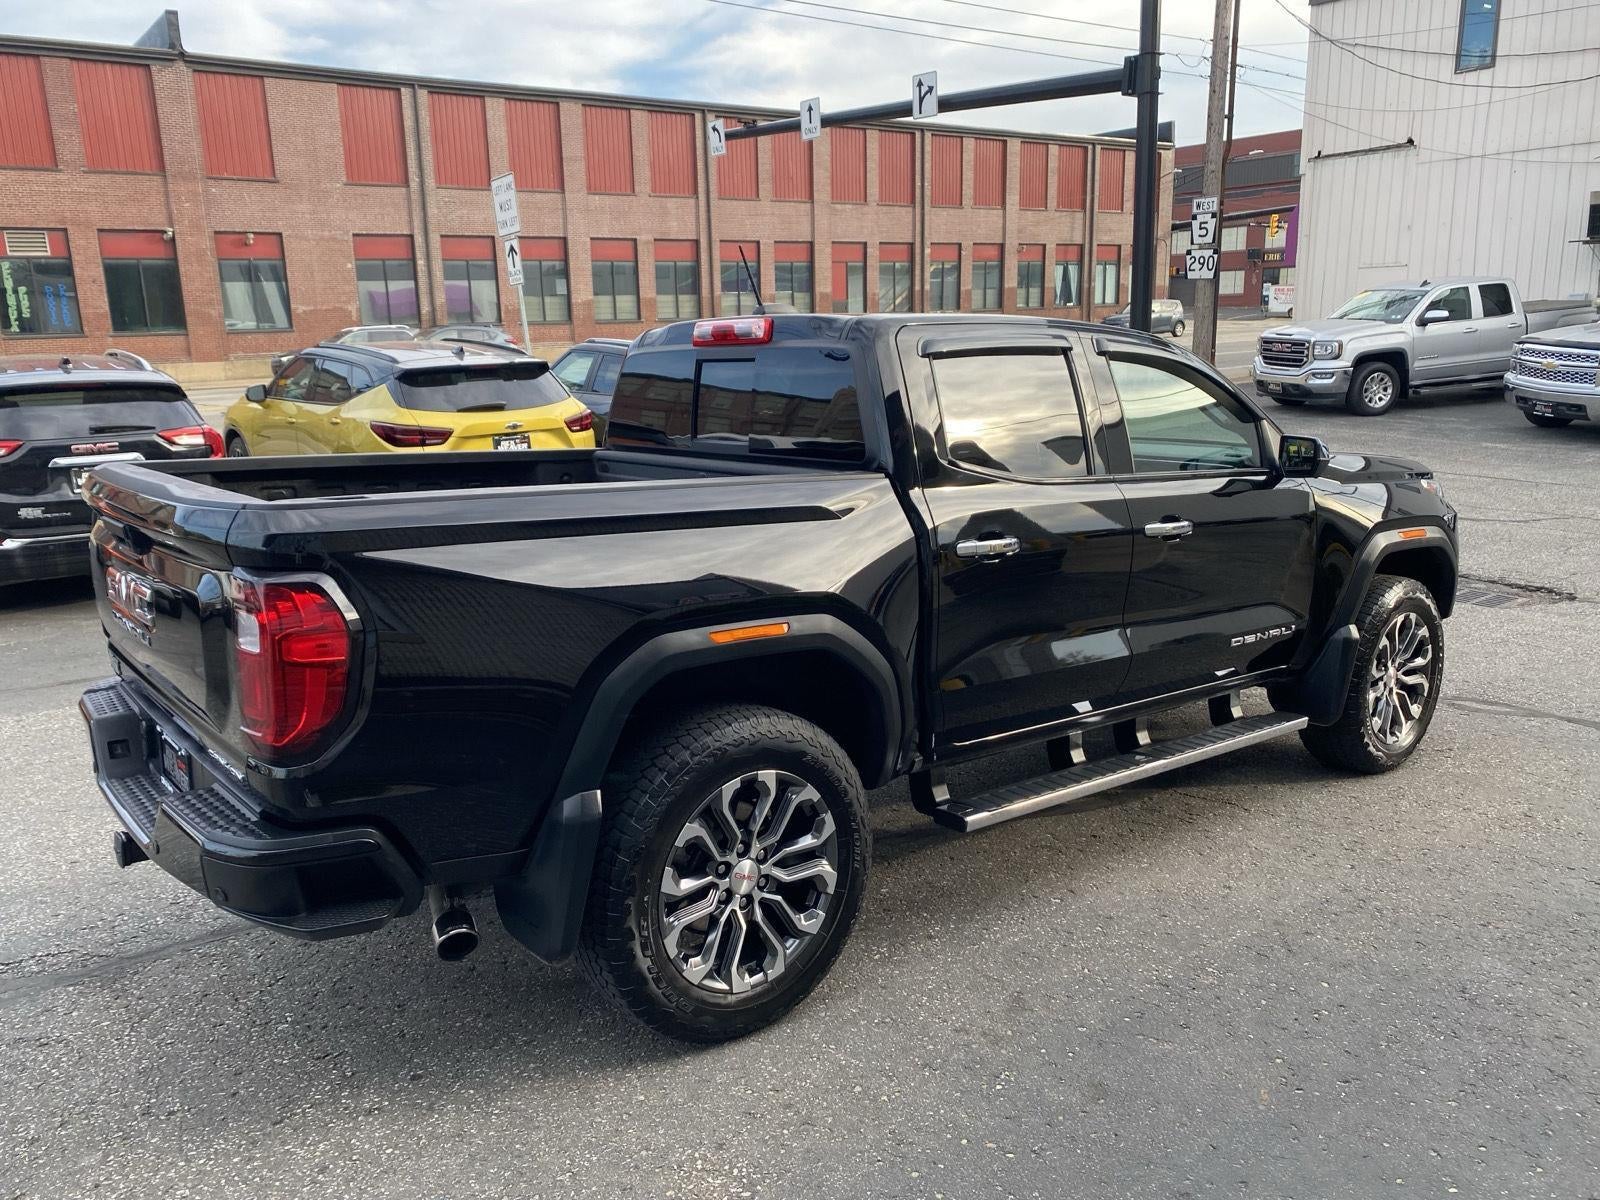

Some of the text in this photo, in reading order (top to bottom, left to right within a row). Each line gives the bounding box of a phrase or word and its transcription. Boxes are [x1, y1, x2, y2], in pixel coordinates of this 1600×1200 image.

[804, 127, 818, 136] ONLY
[498, 198, 512, 212] MUST
[1195, 200, 1216, 211] WEST
[1198, 221, 1209, 238] 5
[1188, 255, 1216, 272] 290
[1271, 342, 1292, 352] GMC
[70, 441, 119, 454] GMC
[105, 566, 156, 627] GMC
[1230, 624, 1296, 647] DENALI
[735, 872, 756, 882] GMC
